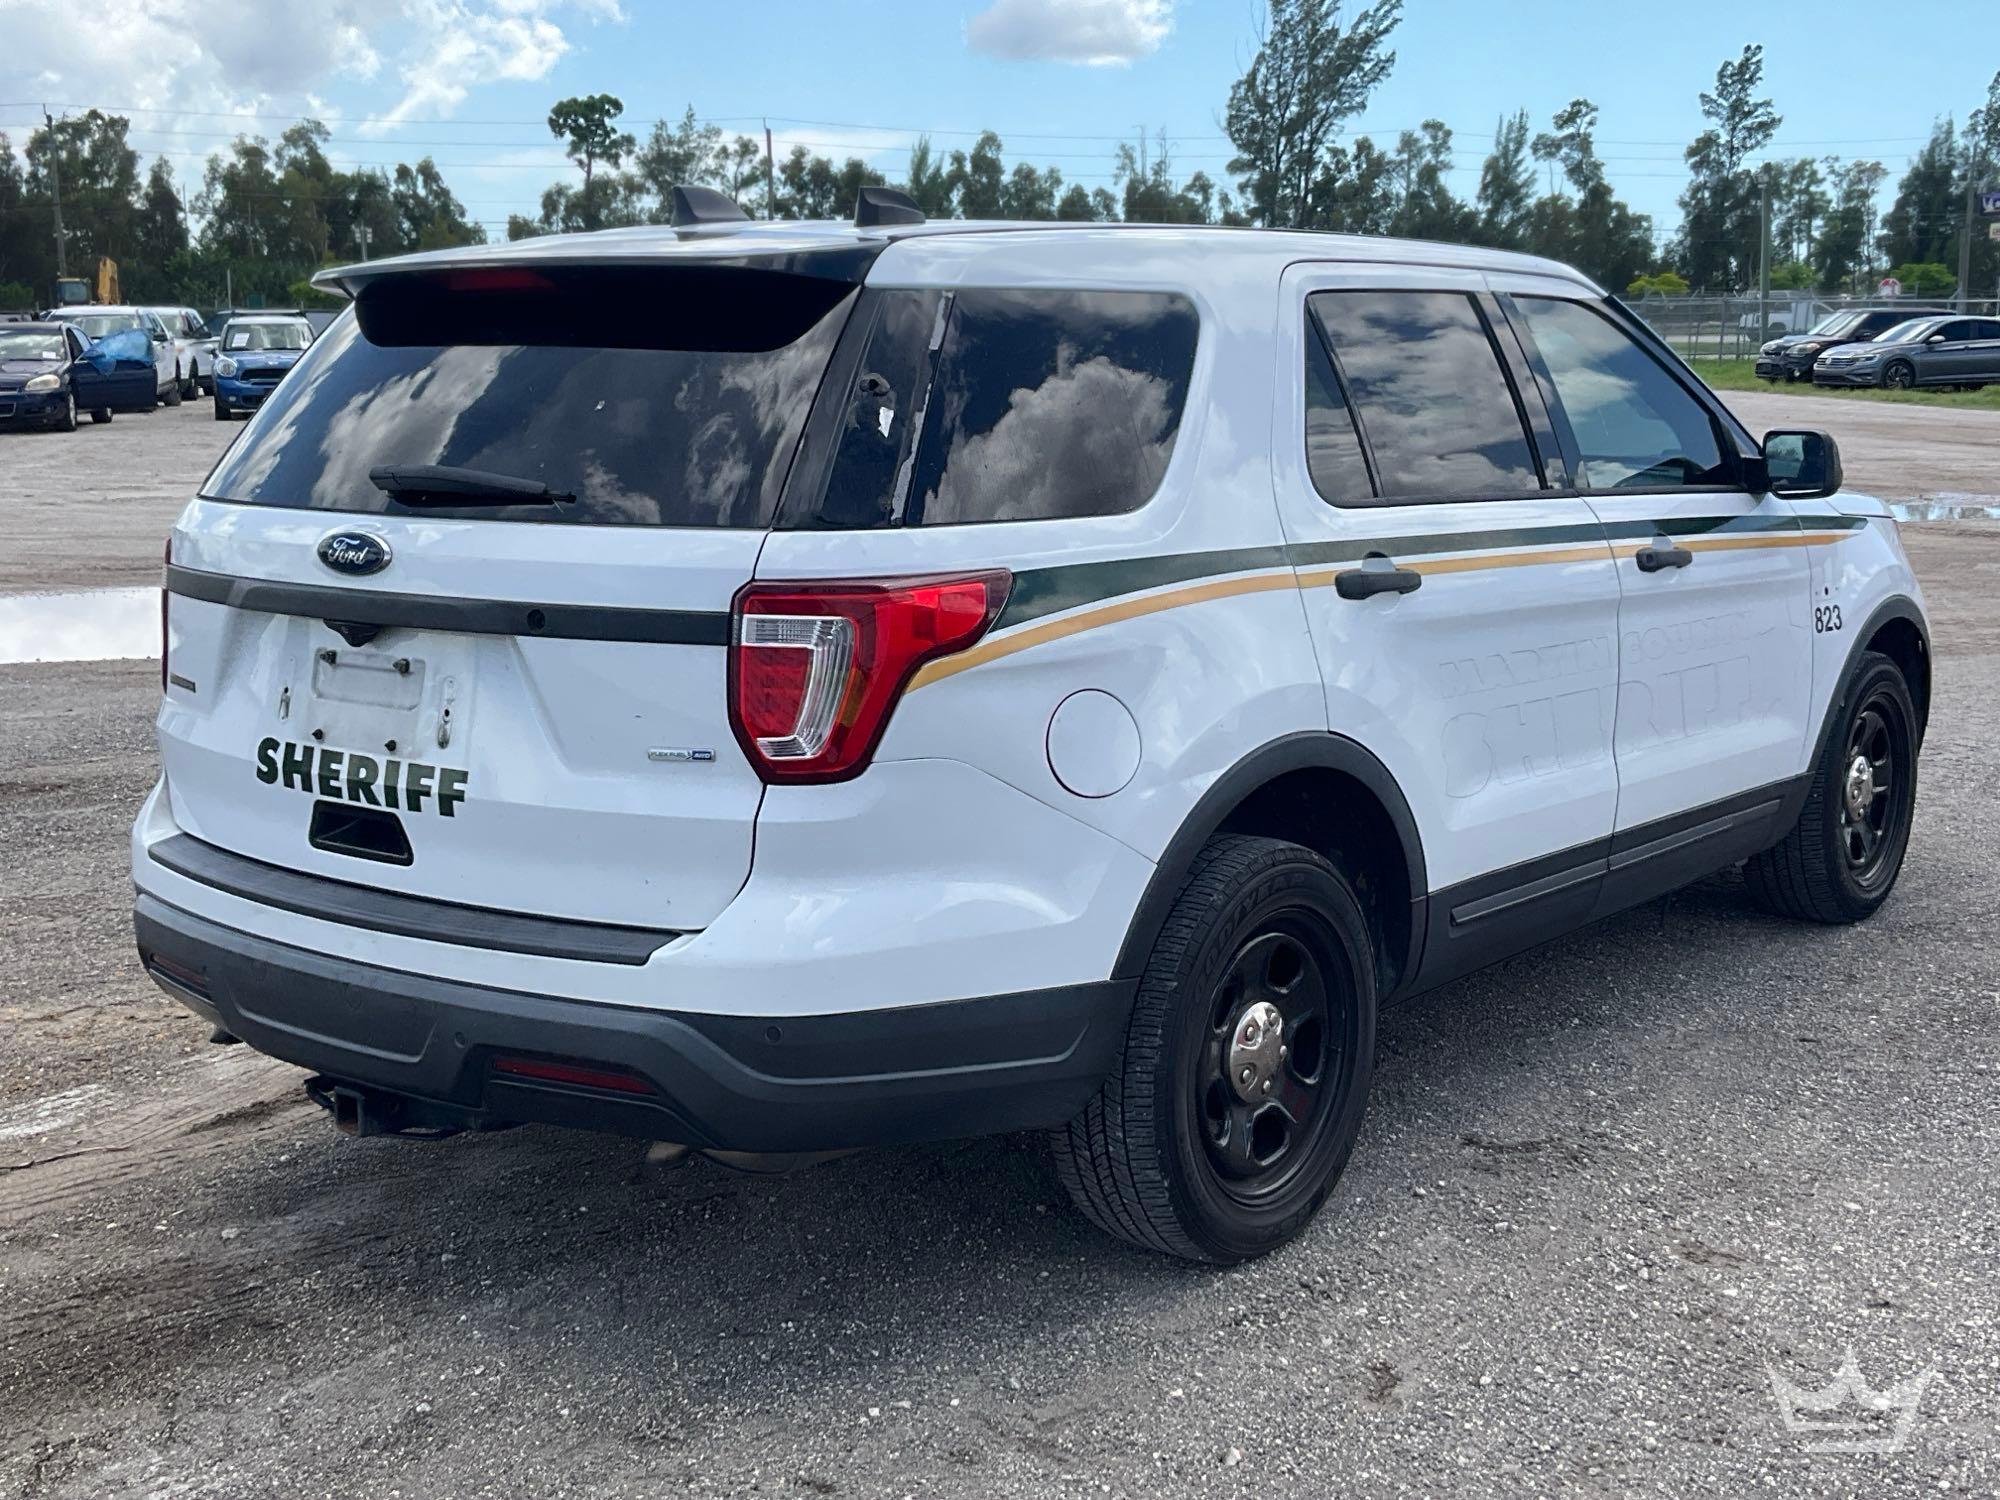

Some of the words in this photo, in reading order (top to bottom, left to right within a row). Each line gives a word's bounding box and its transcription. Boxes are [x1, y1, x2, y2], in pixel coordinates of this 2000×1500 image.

[328, 536, 369, 565] Ford
[1815, 604, 1843, 634] 823
[256, 737, 469, 818] SHERIFF
